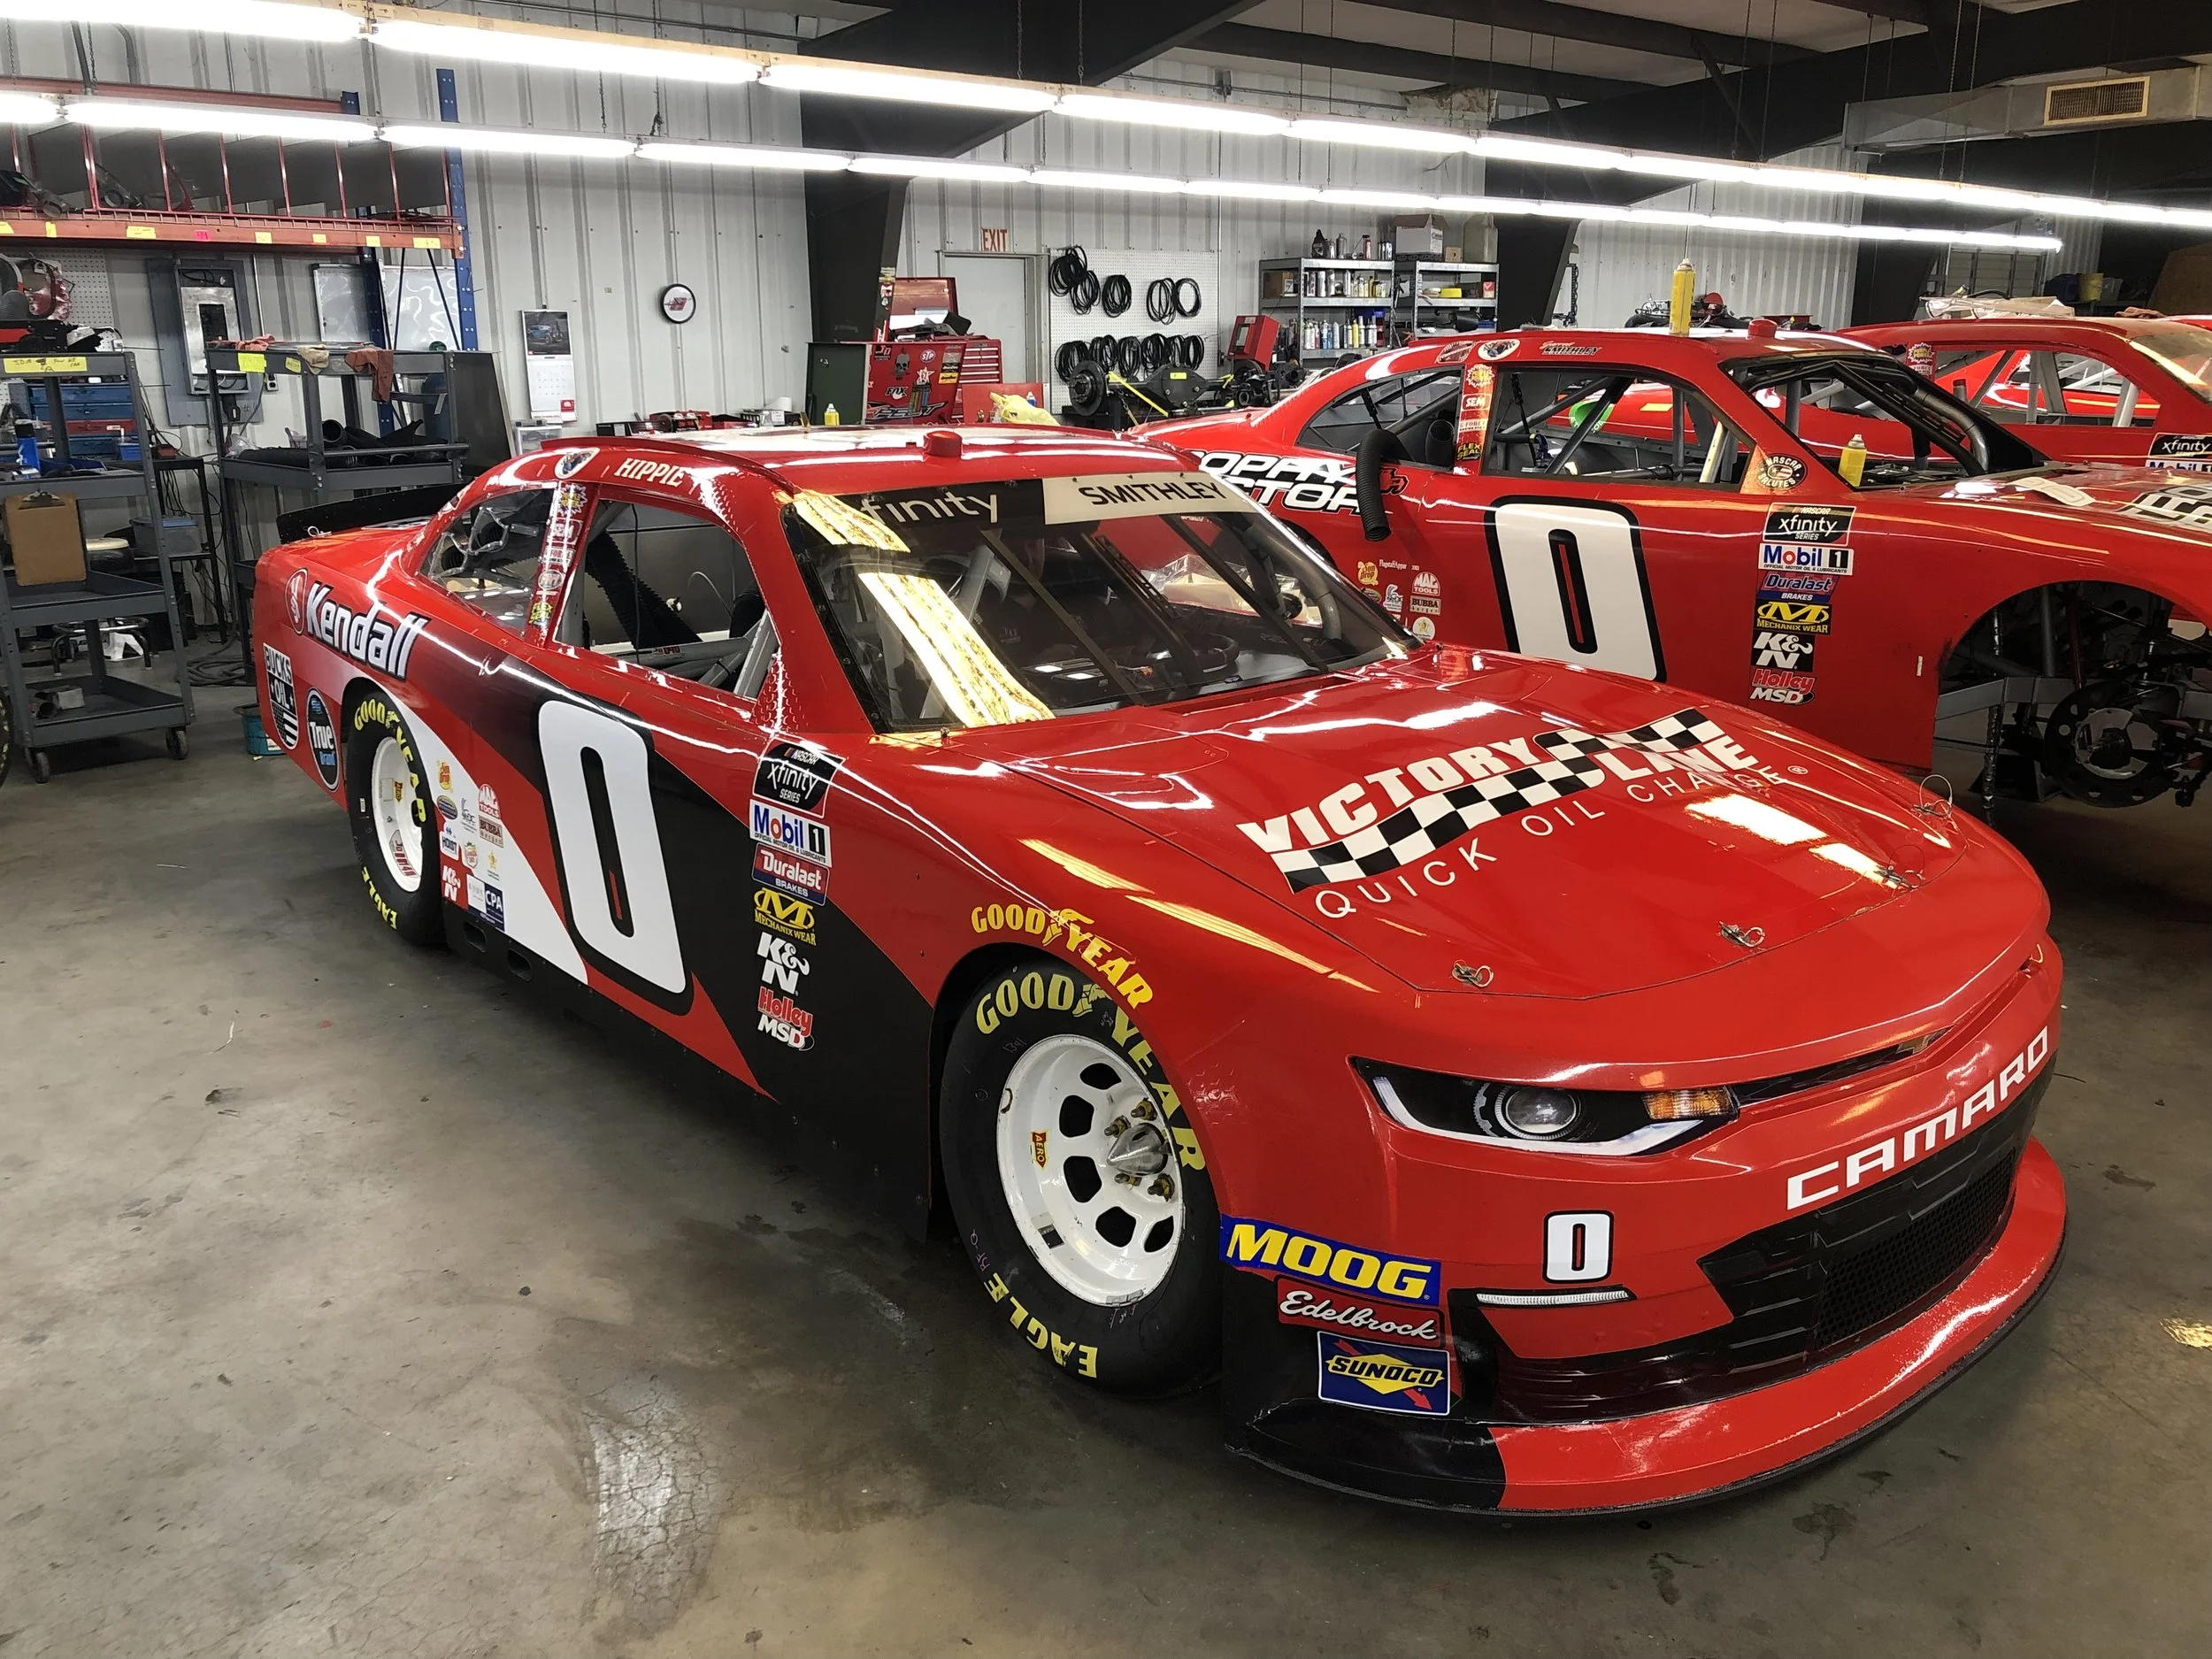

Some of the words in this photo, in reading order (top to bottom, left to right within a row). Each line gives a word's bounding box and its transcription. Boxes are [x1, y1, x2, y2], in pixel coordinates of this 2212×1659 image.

[982, 228, 1008, 252] EXIT
[921, 350, 934, 361] STP
[1465, 397, 1486, 408] SEM
[1457, 442, 1481, 453] FLEX
[1457, 449, 1479, 460] SEAL
[2162, 439, 2212, 453] xfinity
[613, 457, 685, 488] HIPPIE
[1765, 456, 1802, 472] NASCAR
[1078, 480, 1227, 506] SMITHLEY
[1757, 474, 1796, 488] SALUTES
[861, 492, 997, 524] finity
[1800, 506, 1832, 515] NASCAR
[1778, 514, 1838, 537] xfinity
[1763, 544, 1823, 567] Mobil
[1495, 503, 1657, 681] 0
[1765, 574, 1833, 592] Duralast
[1780, 592, 1814, 601] BRAKES
[1411, 598, 1439, 608] BUBBA
[1757, 601, 1830, 625] M
[306, 580, 429, 680] Kendall
[1756, 618, 1801, 632] MECHANIX
[1802, 624, 1829, 634] WEAR
[265, 645, 293, 686] BUCKS
[274, 678, 290, 710] OIL
[1752, 668, 1816, 695] Holley
[1749, 687, 1805, 704] MSD
[309, 721, 334, 749] True
[790, 749, 820, 766] NASCAR
[766, 761, 819, 800] xfinity
[1236, 736, 1544, 853] VICTORY
[1594, 735, 1759, 781] LINE
[780, 787, 802, 804] SERIES
[480, 803, 500, 819] TOOLS
[479, 818, 502, 838] BUBBA
[754, 804, 804, 849] Mobil
[538, 699, 687, 994] 0
[754, 832, 772, 844] OFFICIAL
[772, 838, 788, 849] MOTOR
[800, 848, 826, 864] LUBRICANTS
[1315, 837, 1498, 918] QUICK
[1521, 799, 1606, 837] OIL
[761, 849, 822, 890] Duralast
[485, 889, 503, 912] CPA
[775, 879, 809, 896] BRAKES
[755, 887, 814, 929] M
[755, 910, 794, 937] MECHANIX
[794, 929, 817, 946] WEAR
[757, 985, 814, 1038] Holley
[757, 1014, 806, 1049] MSD
[1786, 1025, 2048, 1210] CAMARO
[1033, 1133, 1045, 1164] AERO
[1547, 1213, 1612, 1281] 0
[1226, 1224, 1432, 1299] MOOG
[982, 1271, 1099, 1379] EAGLE
[1279, 1289, 1439, 1341] Edelbrock
[1328, 1356, 1442, 1388] SUNOCO
